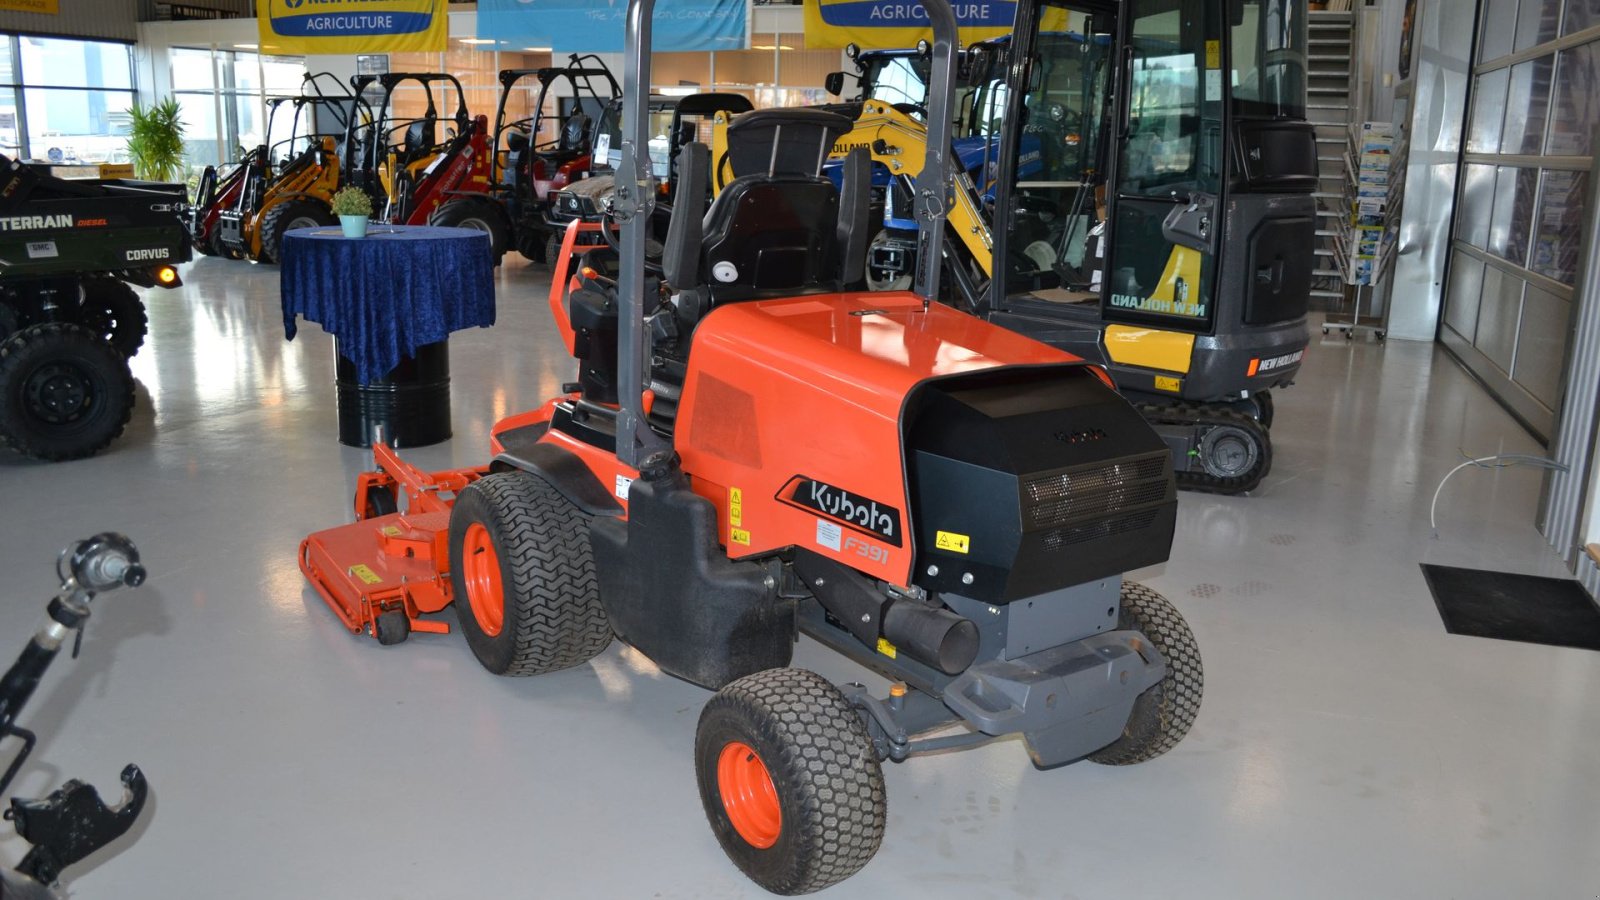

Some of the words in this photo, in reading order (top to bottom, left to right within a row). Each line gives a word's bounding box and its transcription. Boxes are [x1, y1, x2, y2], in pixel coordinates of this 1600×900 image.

[306, 15, 392, 30] AGRICULTURE
[77, 218, 108, 227] DIESEL
[126, 248, 170, 261] CORVUS
[1258, 357, 1278, 371] NEW
[1276, 349, 1303, 368] HOLLAND
[811, 480, 893, 537] Kubota
[844, 536, 889, 565] F391
